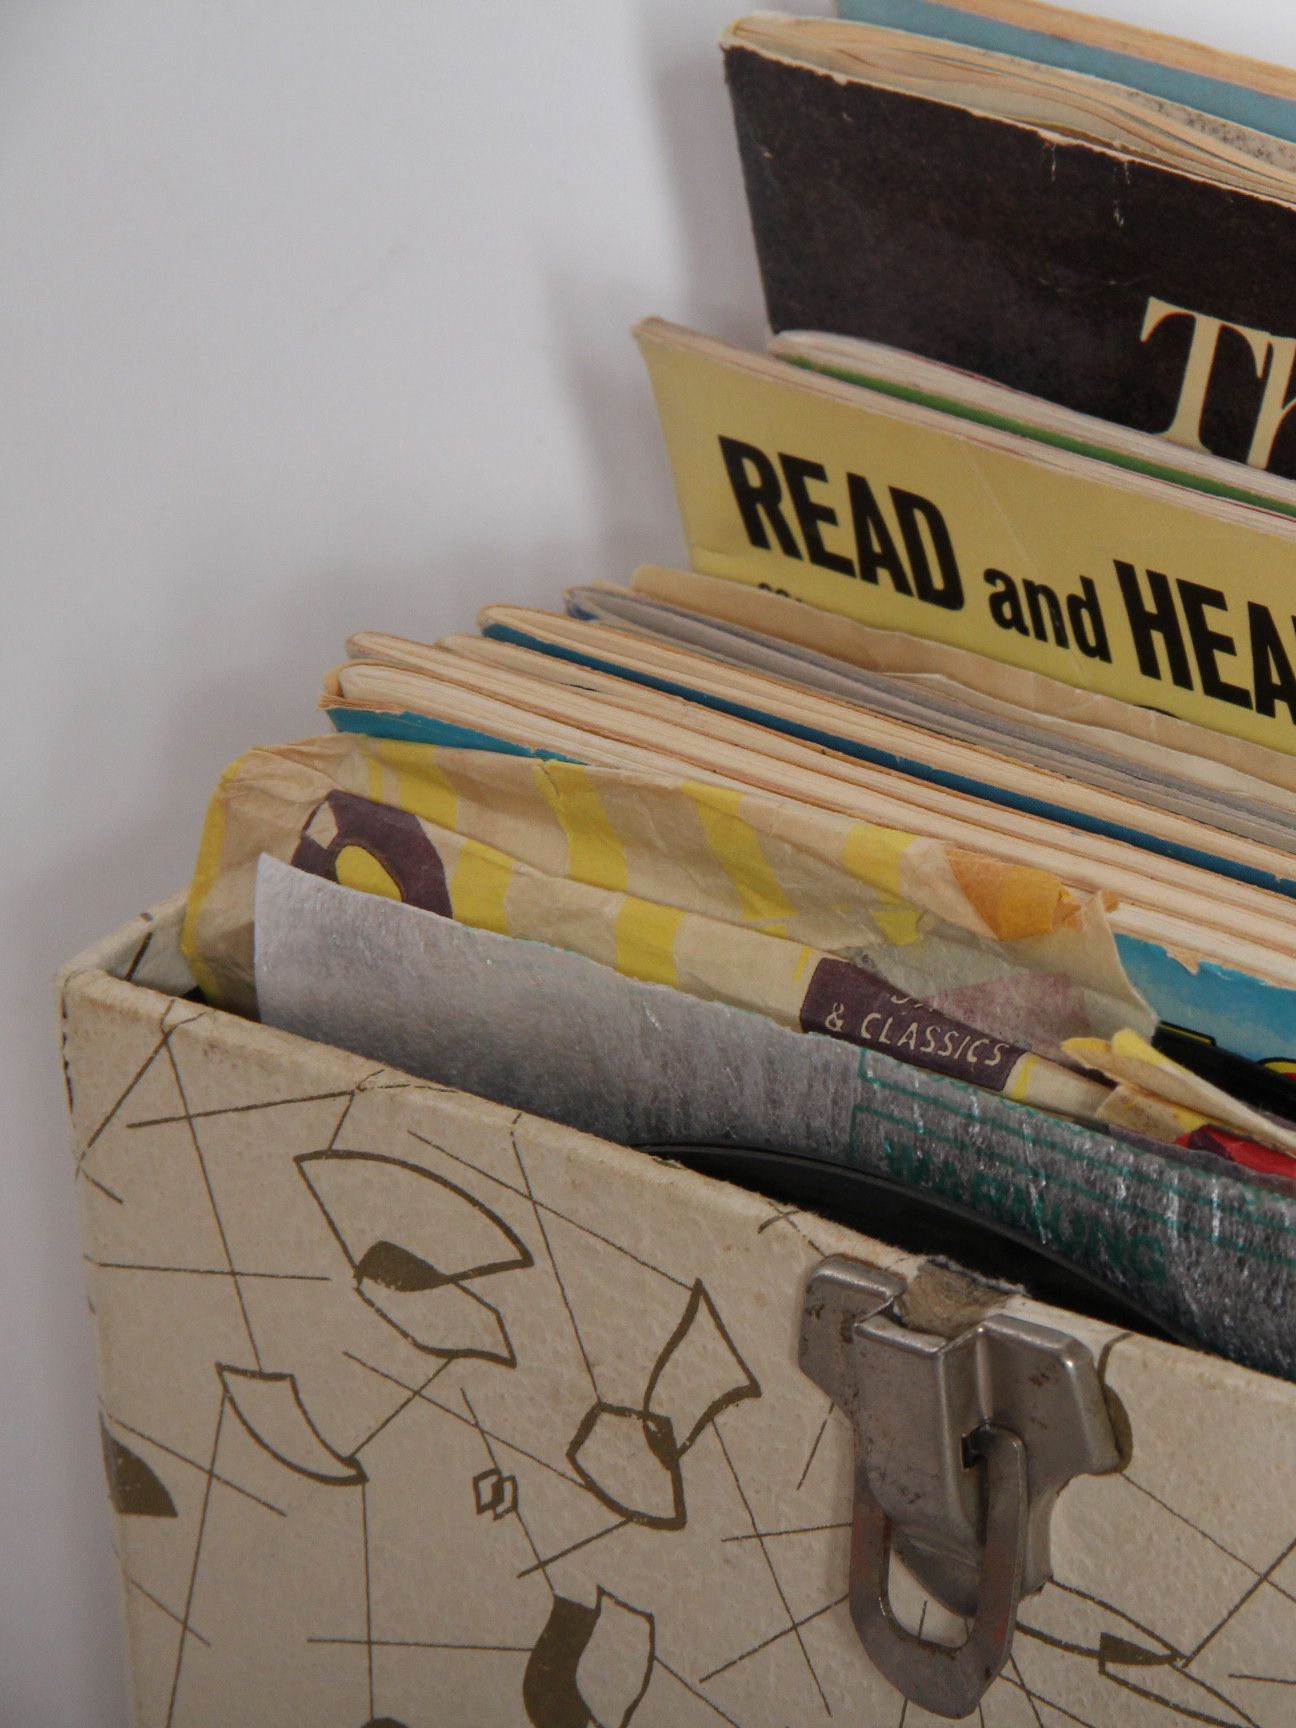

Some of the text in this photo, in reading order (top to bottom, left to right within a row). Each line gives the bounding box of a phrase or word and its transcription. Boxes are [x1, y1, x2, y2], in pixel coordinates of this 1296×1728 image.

[717, 434, 965, 612] READ
[982, 566, 1113, 665] and
[824, 1002, 845, 1033] &
[860, 1012, 1010, 1067] CLASSICS
